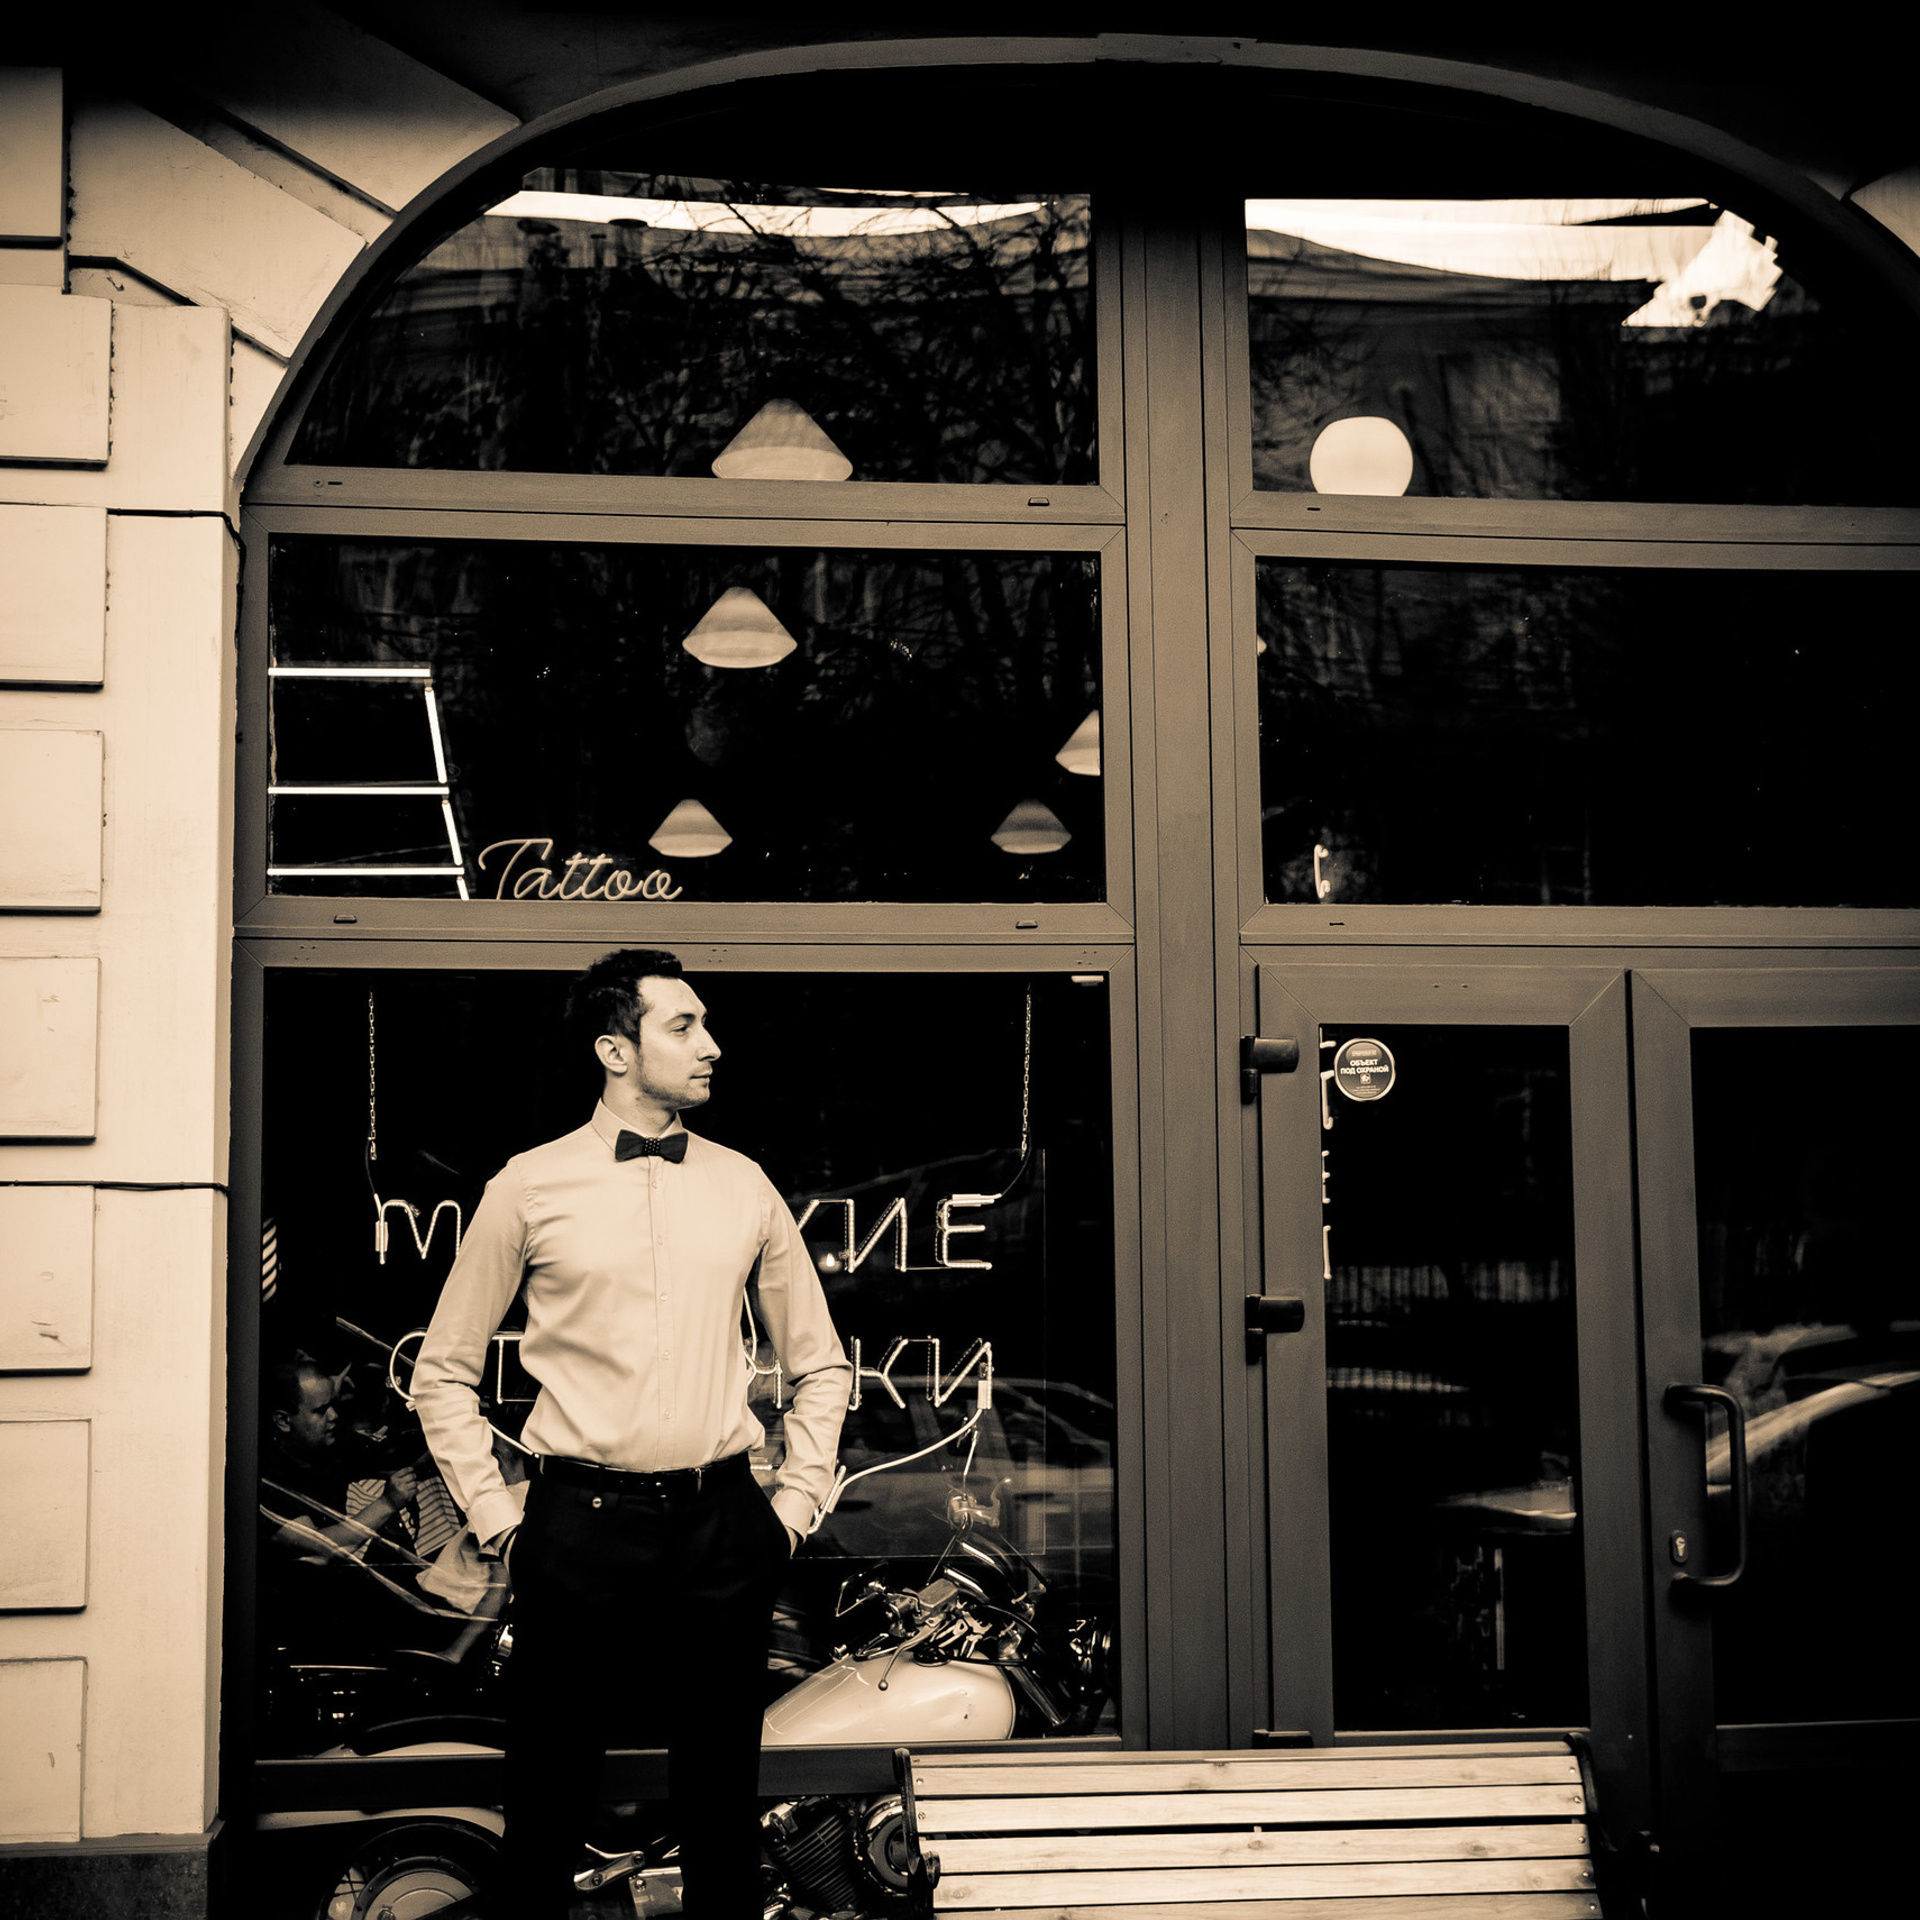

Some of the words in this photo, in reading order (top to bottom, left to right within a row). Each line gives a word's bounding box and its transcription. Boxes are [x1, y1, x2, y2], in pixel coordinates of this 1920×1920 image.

[478, 838, 683, 900] Tattoo
[1349, 1059, 1379, 1067] ОБЪЕКТ
[1340, 1067, 1356, 1075] ПОД
